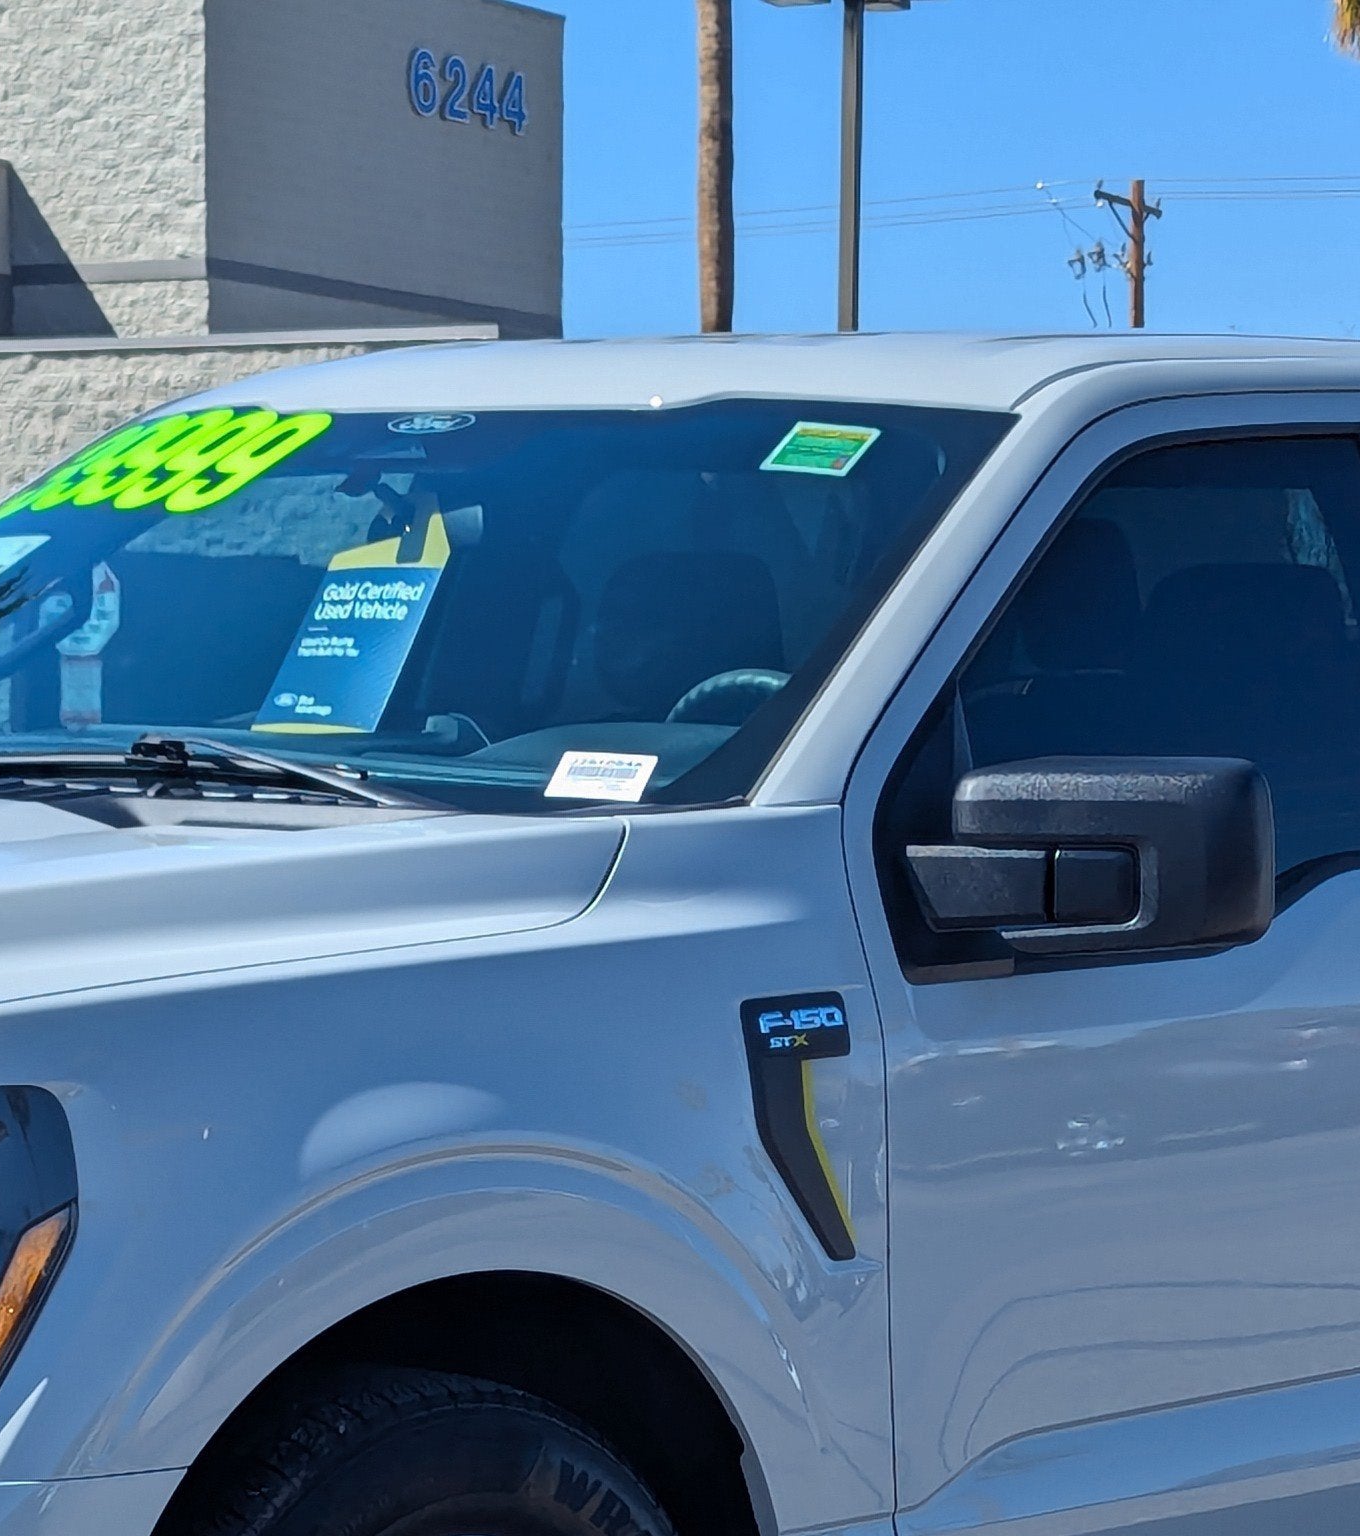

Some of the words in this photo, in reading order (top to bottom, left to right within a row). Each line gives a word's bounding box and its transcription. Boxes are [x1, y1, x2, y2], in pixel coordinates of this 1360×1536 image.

[409, 48, 527, 136] 6244
[323, 582, 360, 601] Gold
[357, 580, 426, 601] Certified
[314, 600, 354, 620] Used
[354, 600, 408, 620] Vehicle
[758, 1005, 844, 1034] F-150
[769, 1033, 809, 1049] STX
